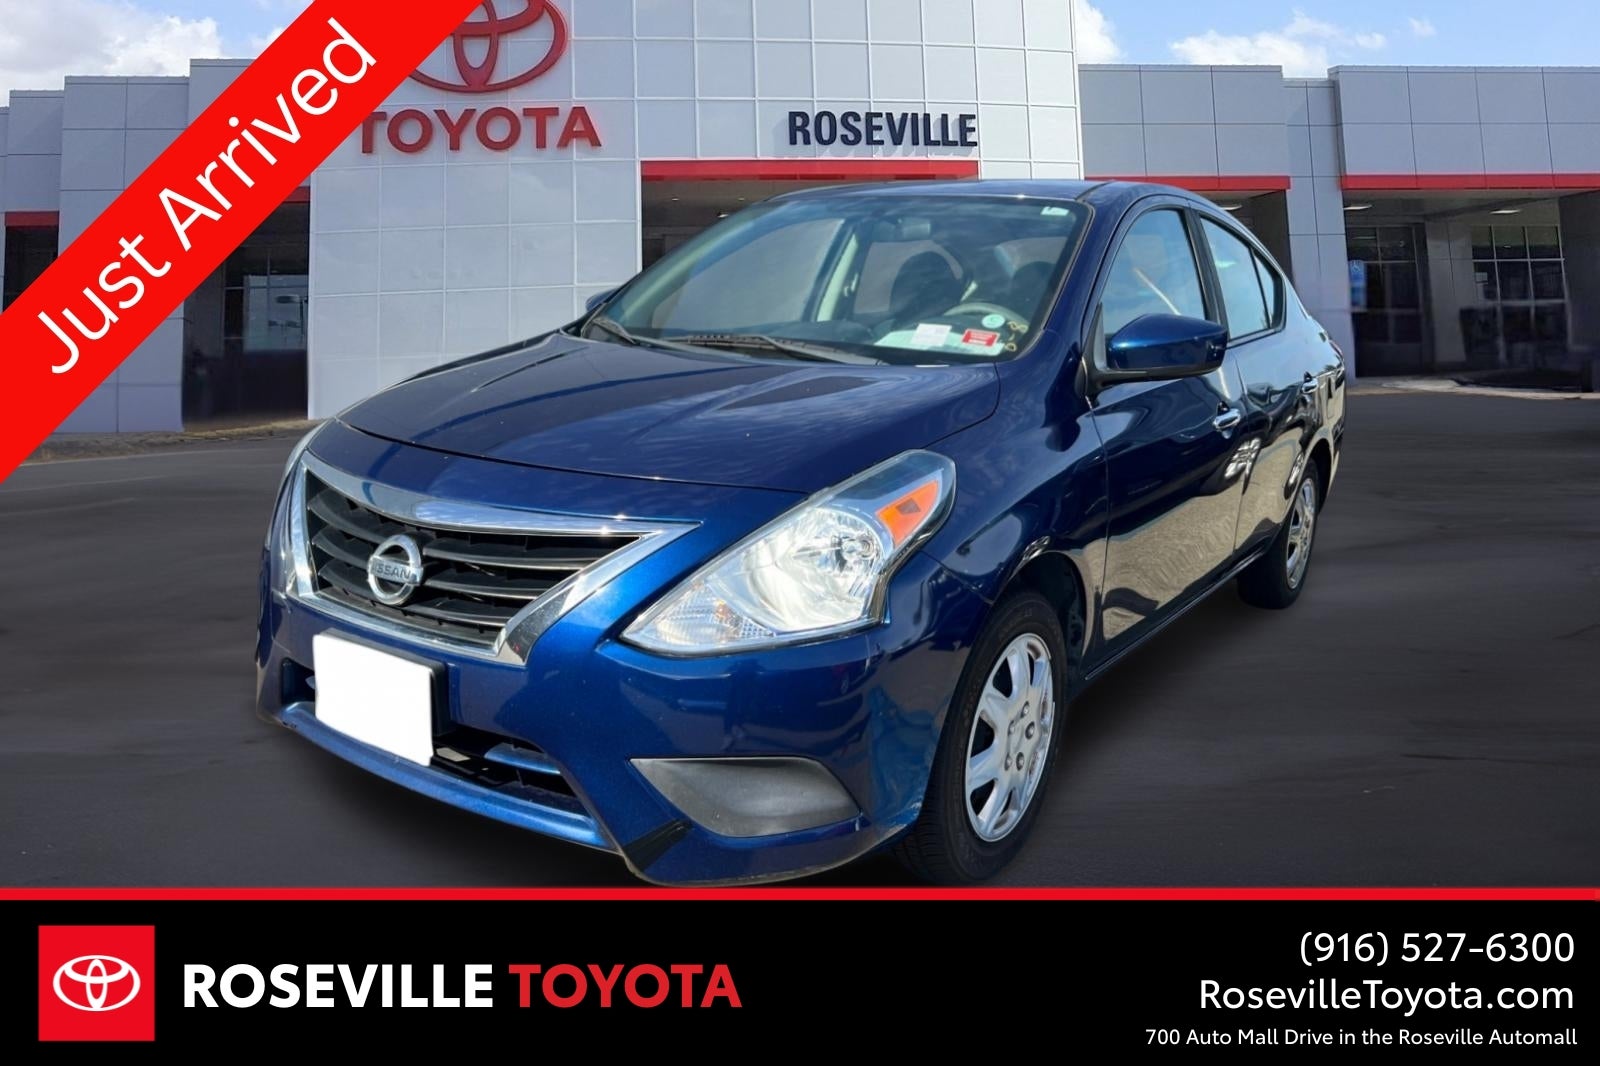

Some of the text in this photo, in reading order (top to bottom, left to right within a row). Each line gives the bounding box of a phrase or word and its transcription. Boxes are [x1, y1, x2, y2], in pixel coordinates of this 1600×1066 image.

[361, 106, 602, 153] TOYOTA
[788, 110, 978, 147] ROSEVILLE
[371, 560, 412, 580] SSAN
